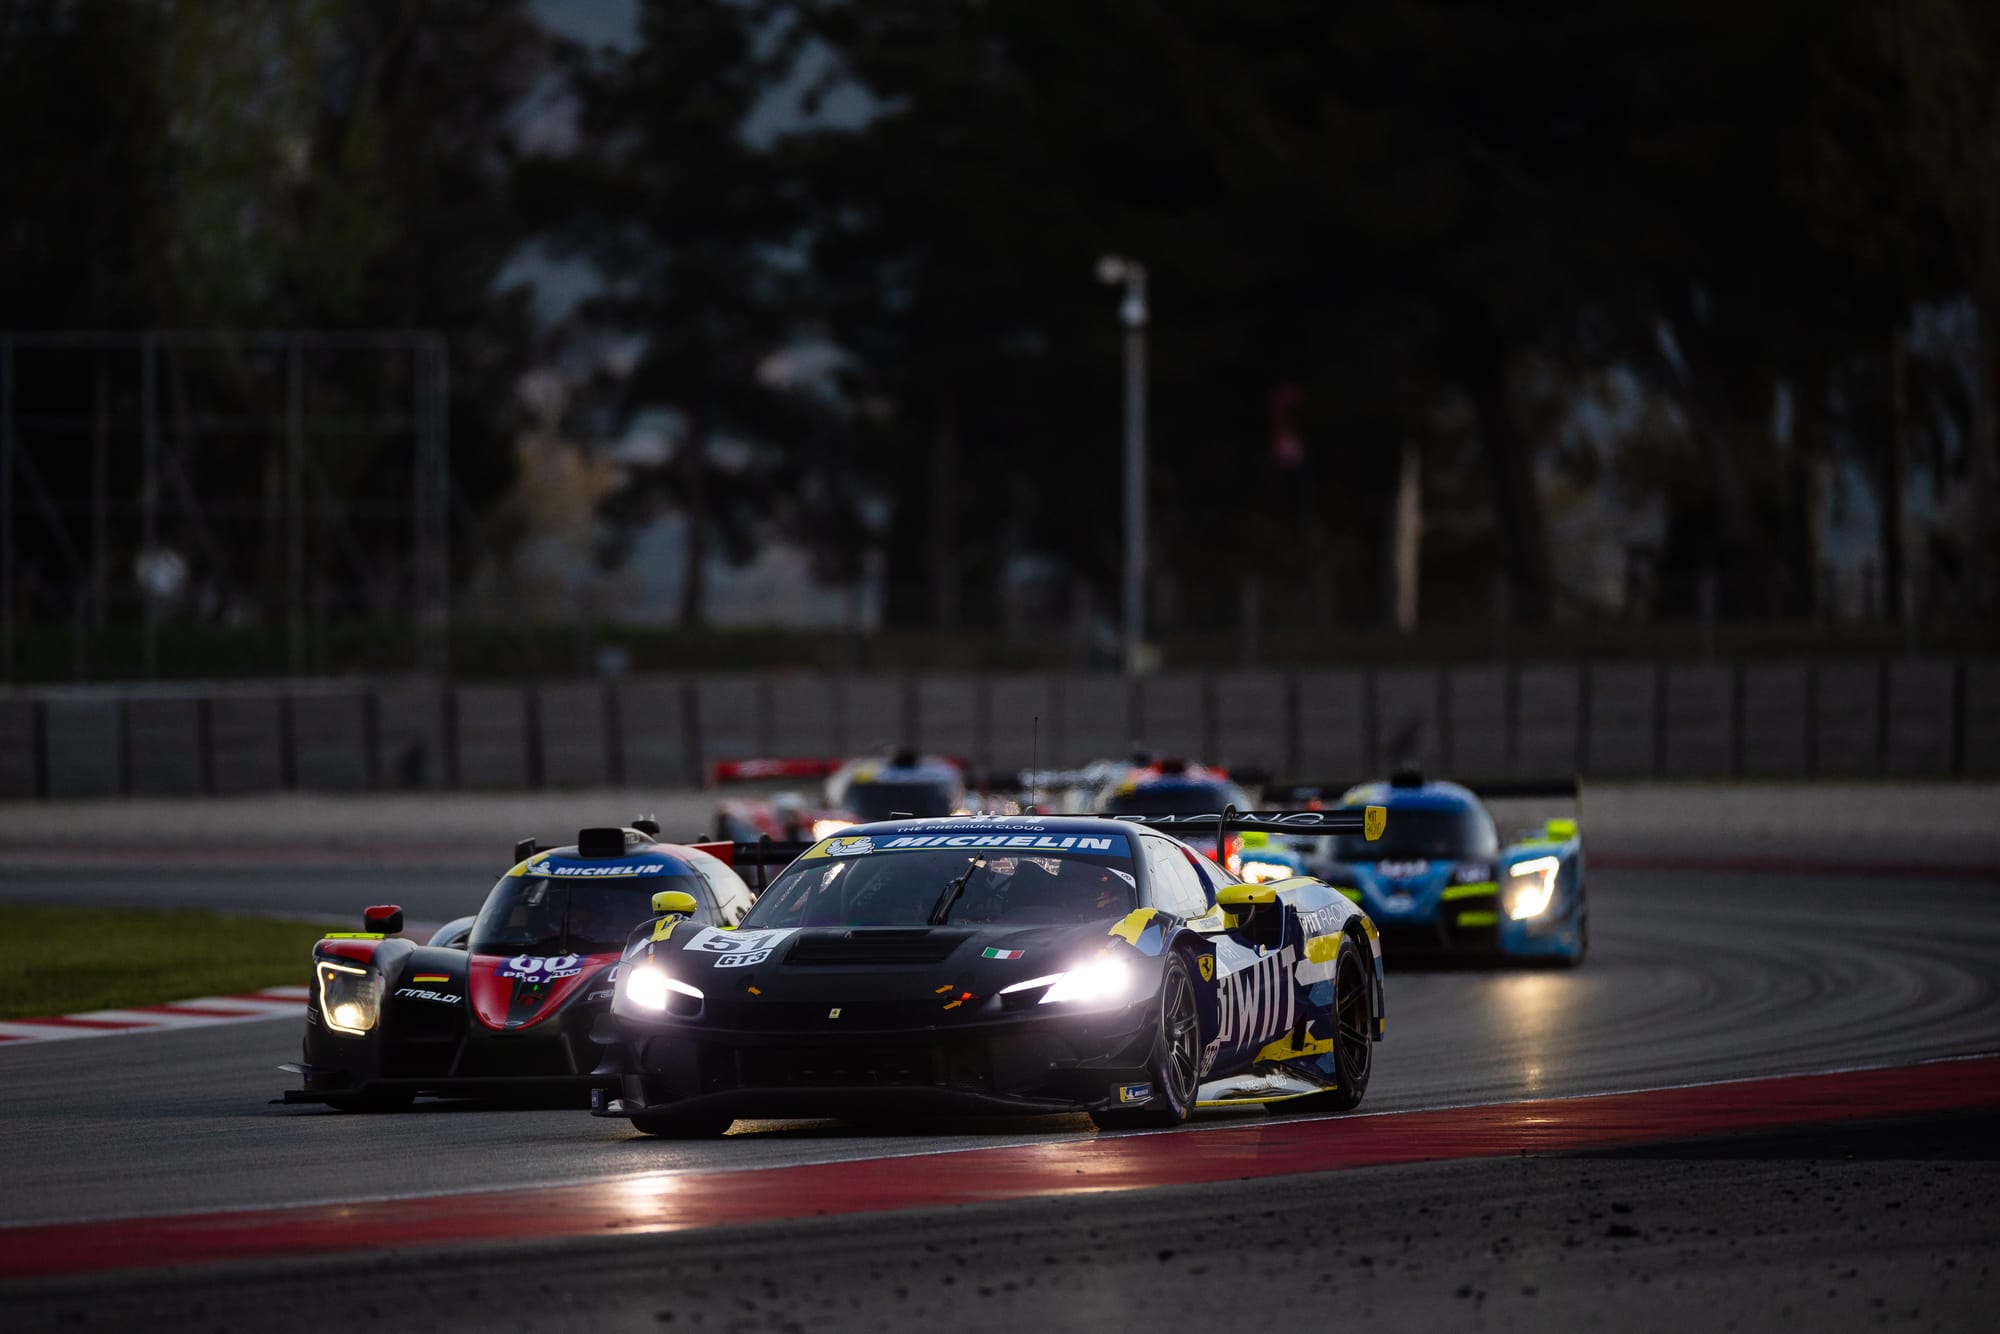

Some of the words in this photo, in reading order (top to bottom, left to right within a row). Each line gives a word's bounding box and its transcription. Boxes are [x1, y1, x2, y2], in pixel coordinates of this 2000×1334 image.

[925, 824, 993, 832] PREMIUM
[884, 835, 1113, 850] MICHELIN
[554, 864, 665, 876] MICHELIN
[702, 934, 776, 951] 51
[718, 950, 768, 966] GT3
[503, 971, 540, 982] PRO
[1233, 944, 1297, 1056] WIIT
